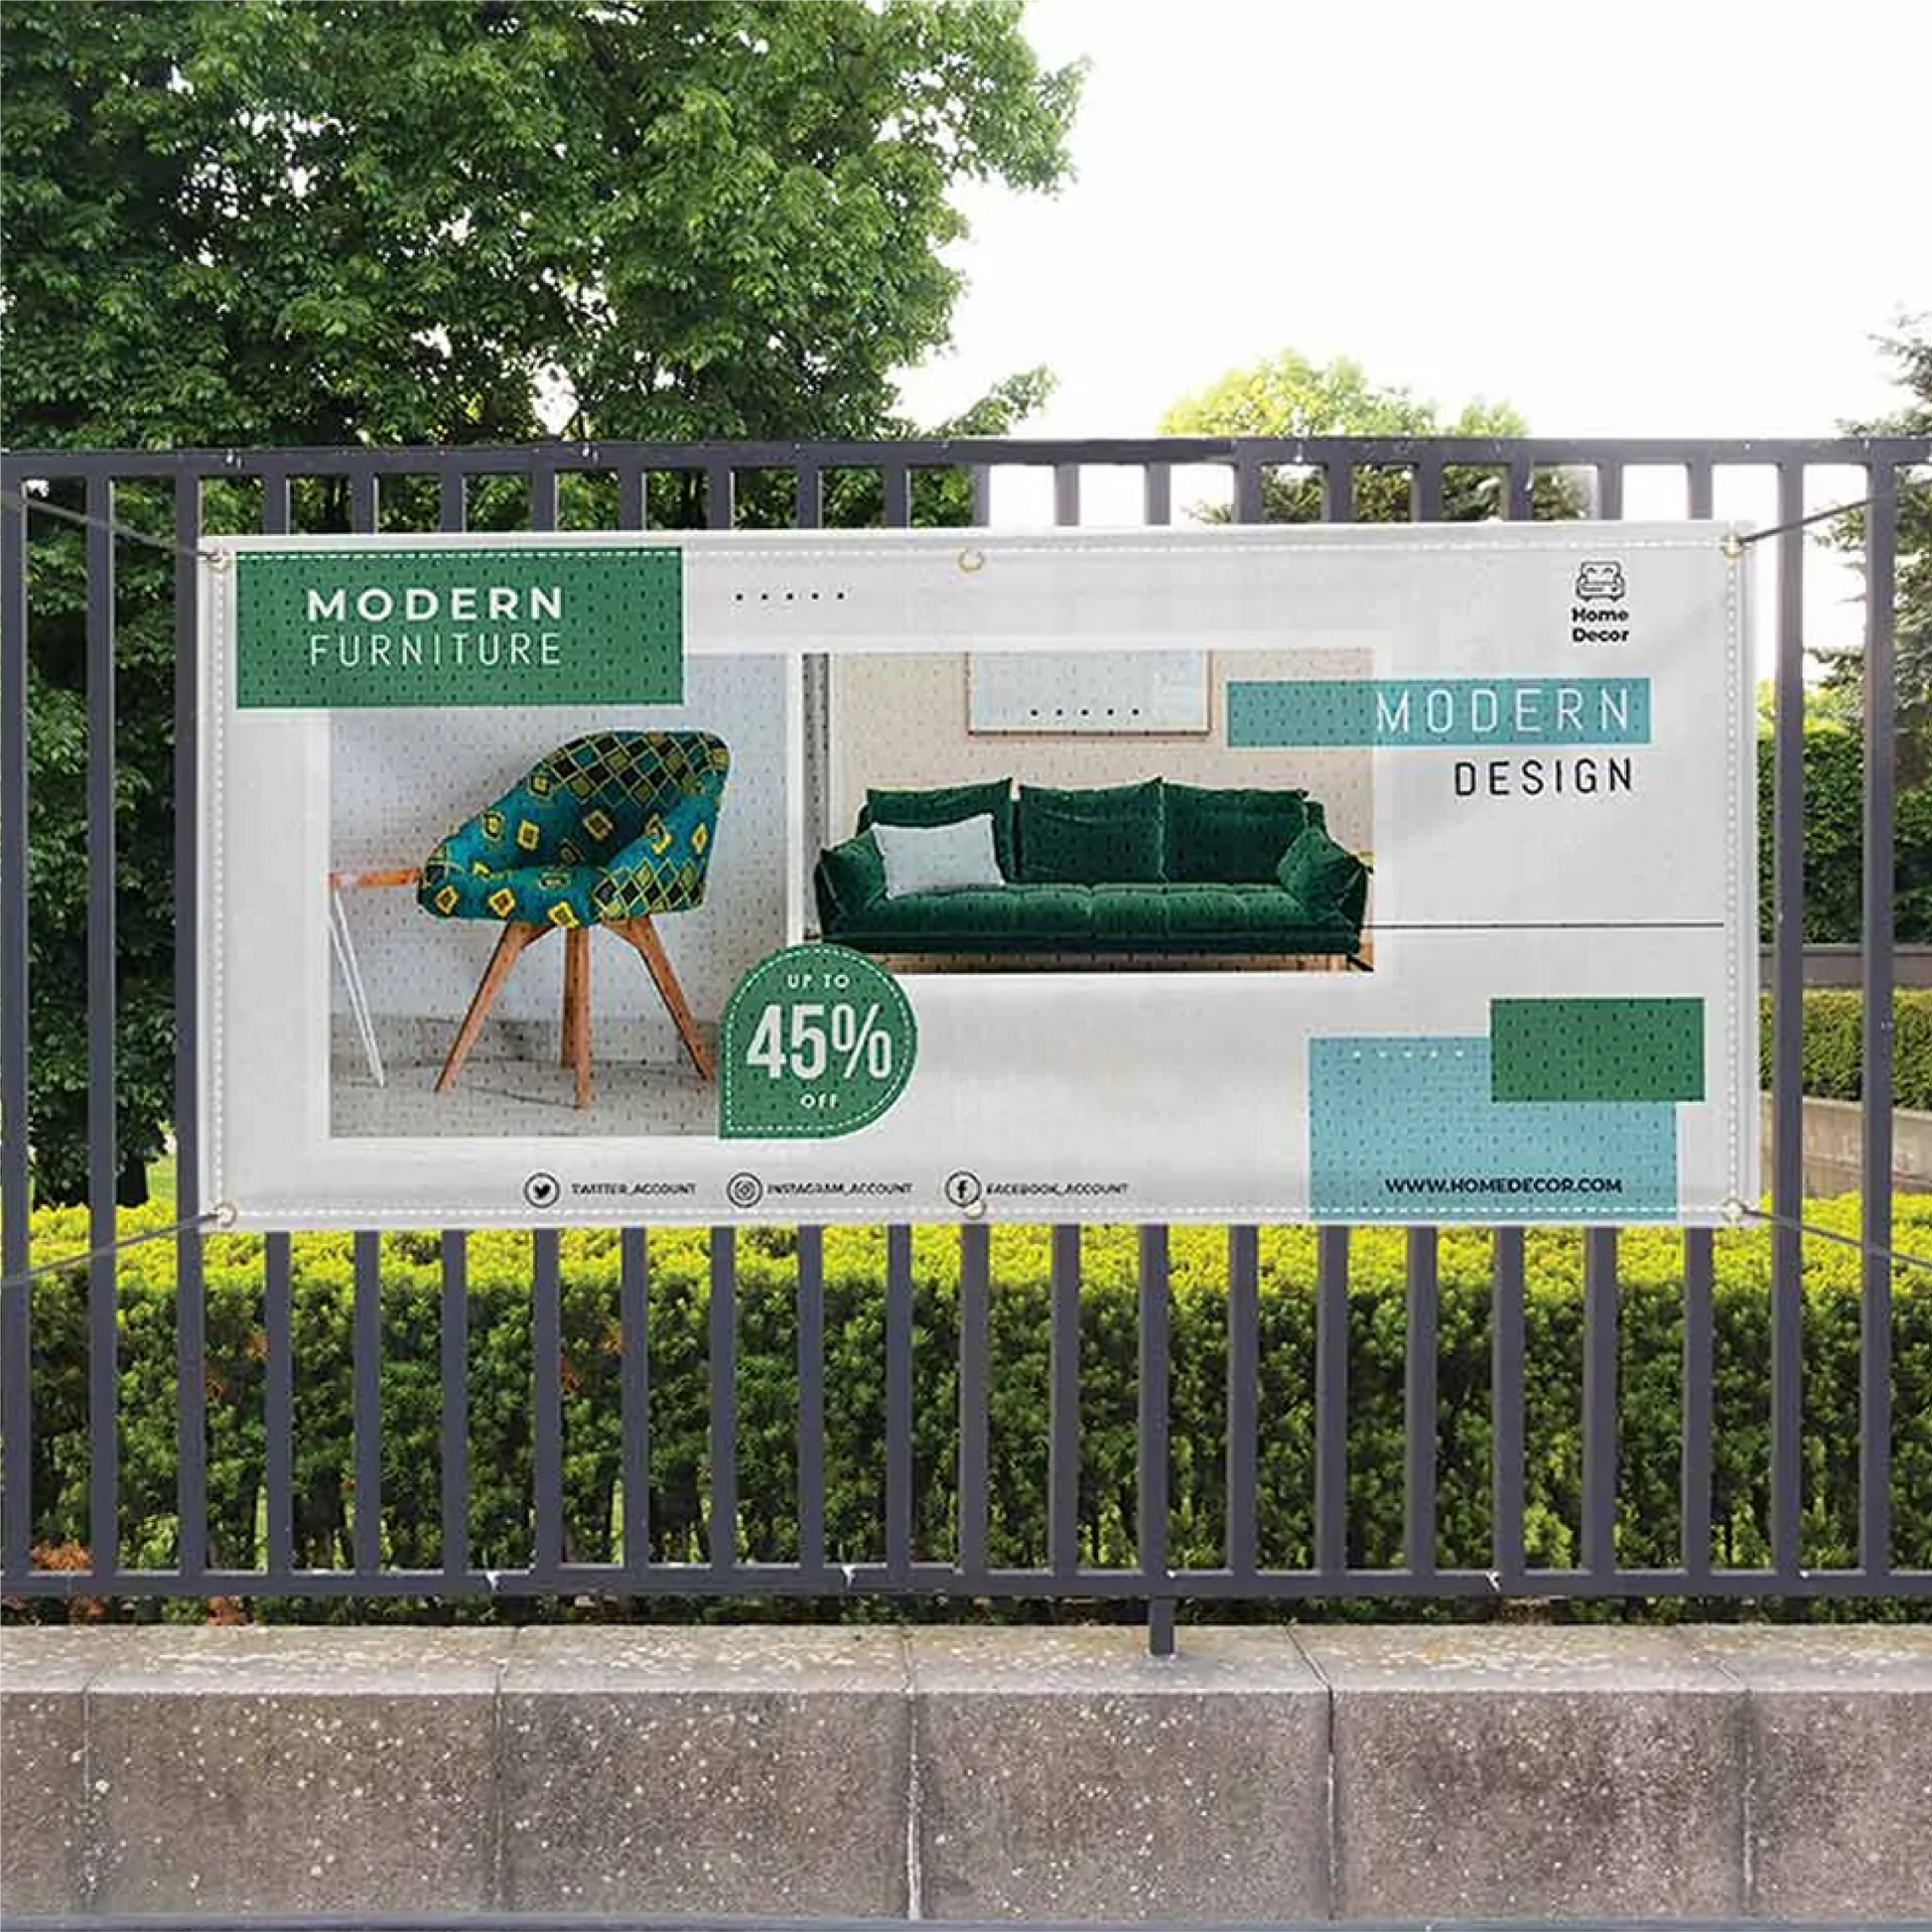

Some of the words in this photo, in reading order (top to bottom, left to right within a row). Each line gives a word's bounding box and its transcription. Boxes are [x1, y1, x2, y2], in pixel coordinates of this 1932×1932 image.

[308, 589, 562, 621] MODERN
[1572, 608, 1629, 622] Home
[311, 632, 561, 666] FURNITURE
[1573, 627, 1629, 642] Decor
[1376, 688, 1629, 733] MODERN
[1455, 759, 1633, 796] DESIGN
[787, 974, 812, 989] UP
[823, 974, 852, 989] TO
[746, 1003, 893, 1079] 45%
[1385, 1177, 1623, 1193] WWW.HOMEDECOR.COM
